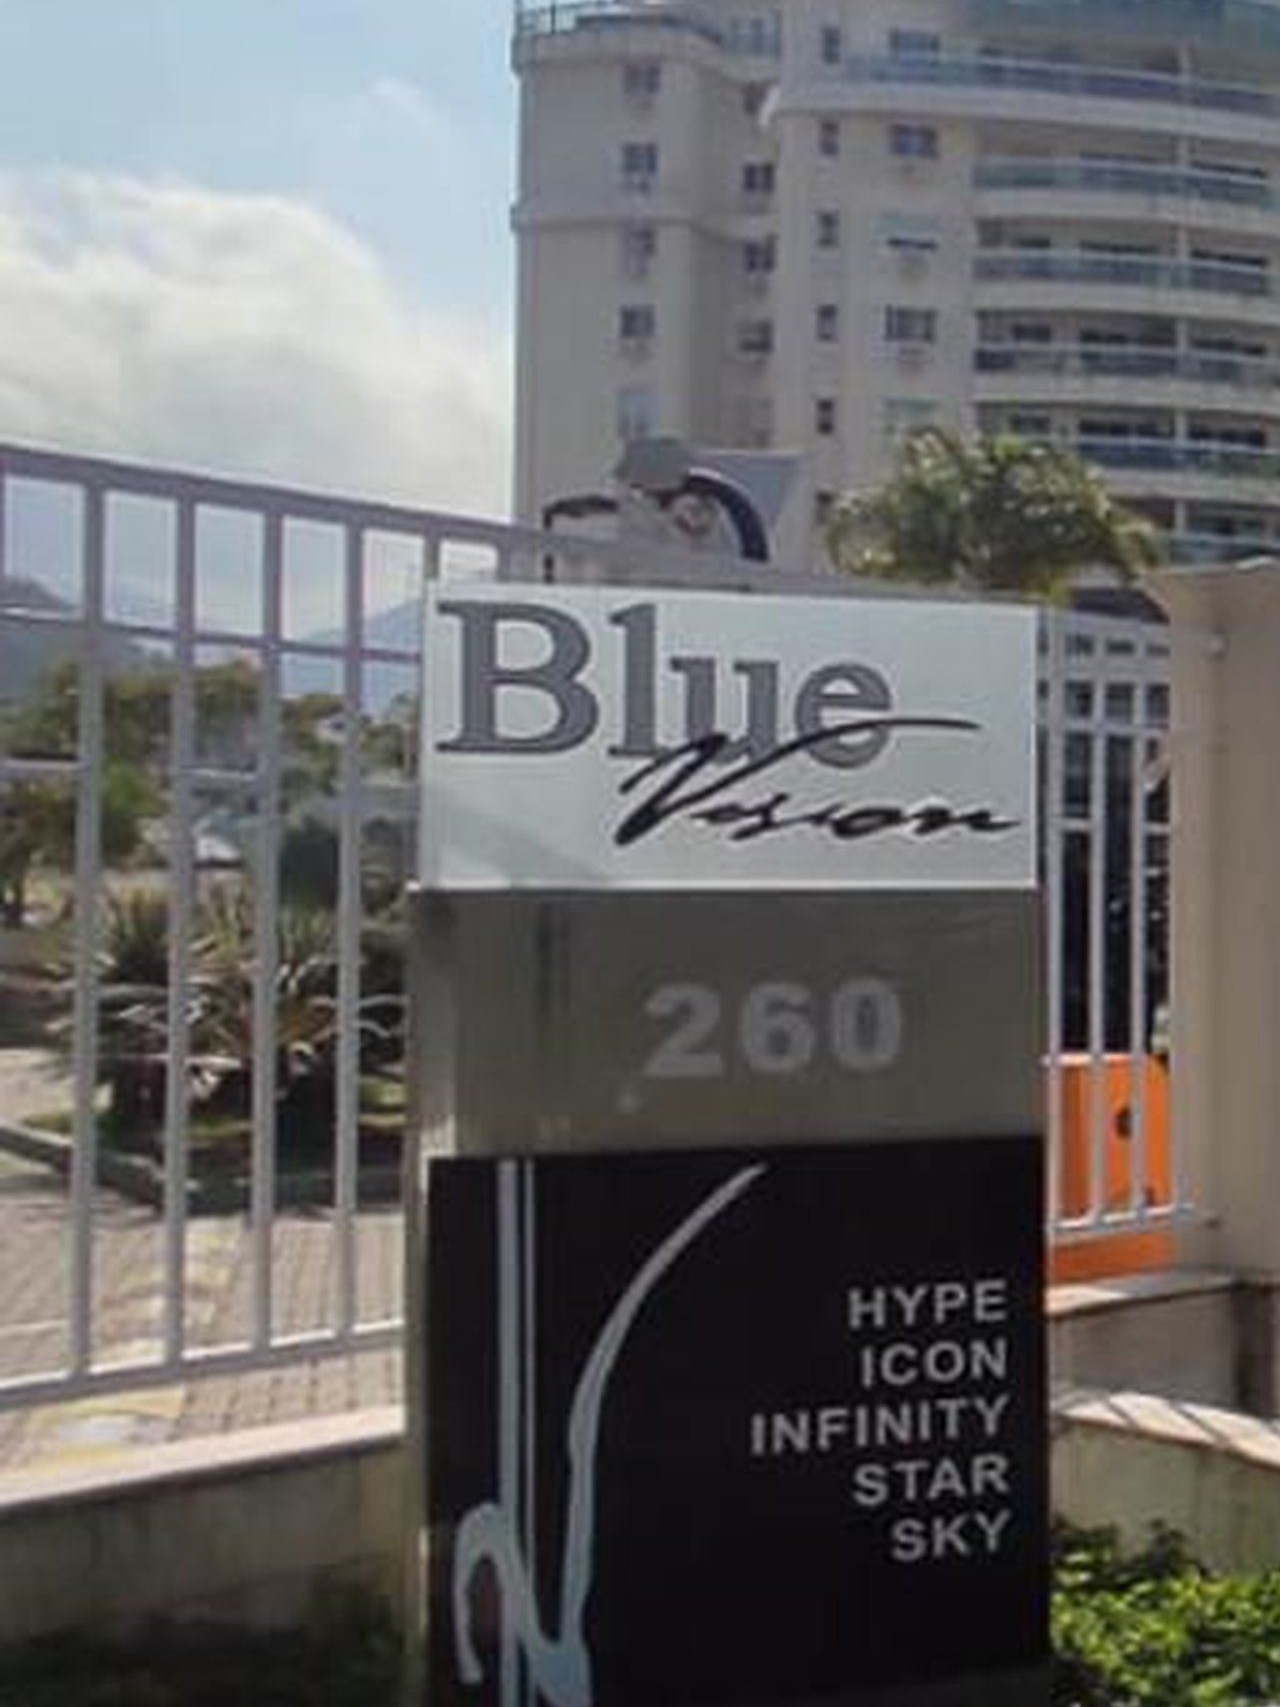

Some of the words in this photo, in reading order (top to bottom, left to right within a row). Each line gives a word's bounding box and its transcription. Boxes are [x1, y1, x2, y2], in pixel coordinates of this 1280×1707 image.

[435, 601, 893, 769] Blue
[644, 978, 901, 1077] 260
[848, 1280, 1008, 1329] HYPE
[861, 1338, 1008, 1388] ICON
[750, 1396, 1010, 1455] INFINITY
[854, 1457, 1011, 1506] STAR
[892, 1512, 1012, 1561] SKY
